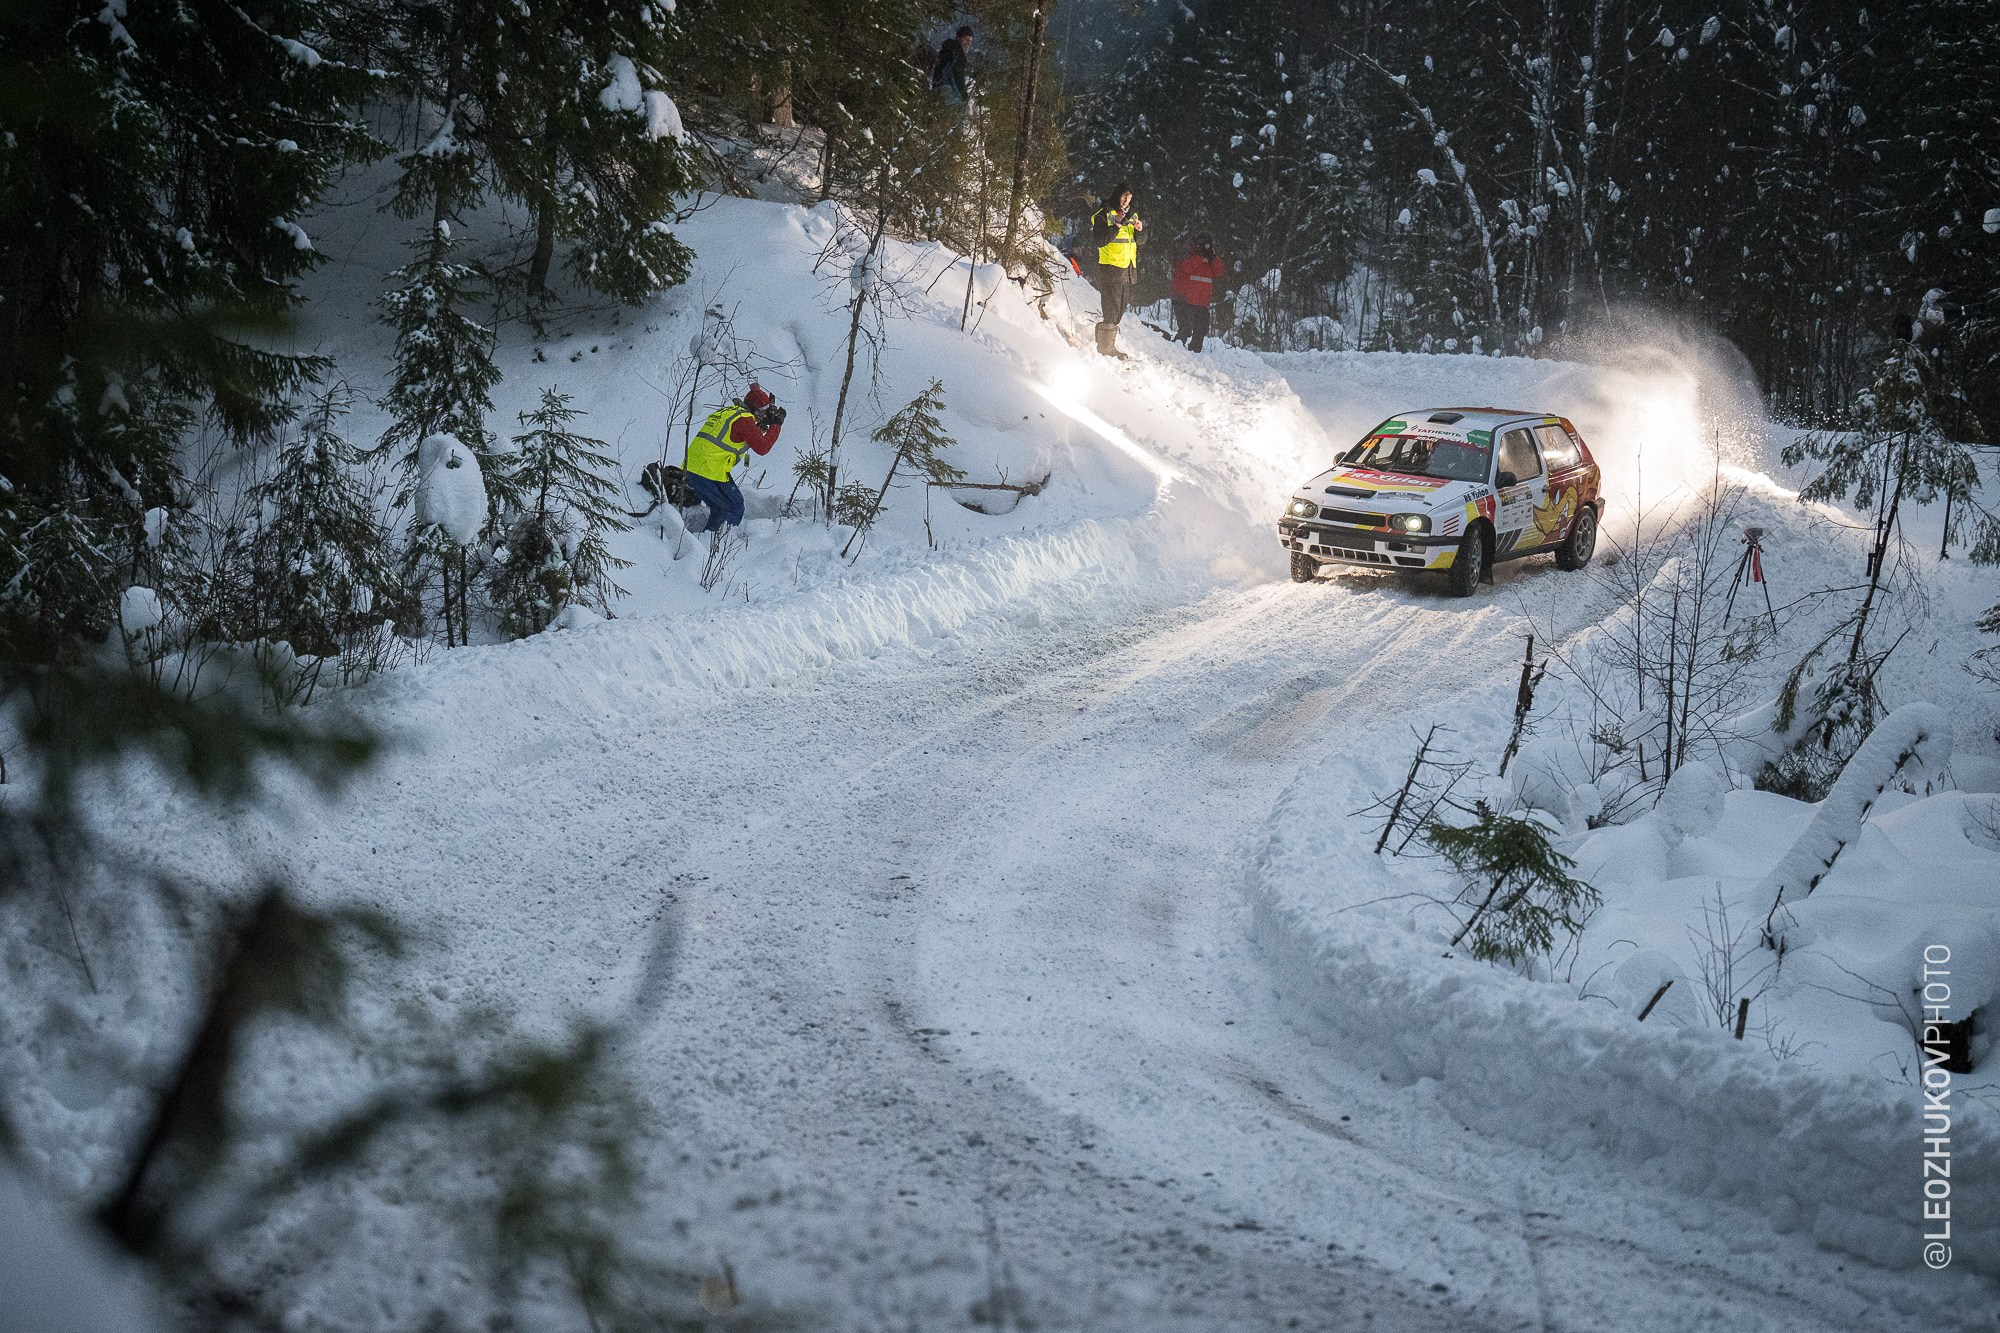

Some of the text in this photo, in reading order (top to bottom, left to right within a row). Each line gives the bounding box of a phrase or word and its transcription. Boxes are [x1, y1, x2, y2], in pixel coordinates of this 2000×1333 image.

[1417, 428, 1462, 437] ТАТНЕФТЬ
[1361, 438, 1379, 449] 48
[1463, 493, 1472, 504] RE
[1471, 488, 1489, 499] Vision
